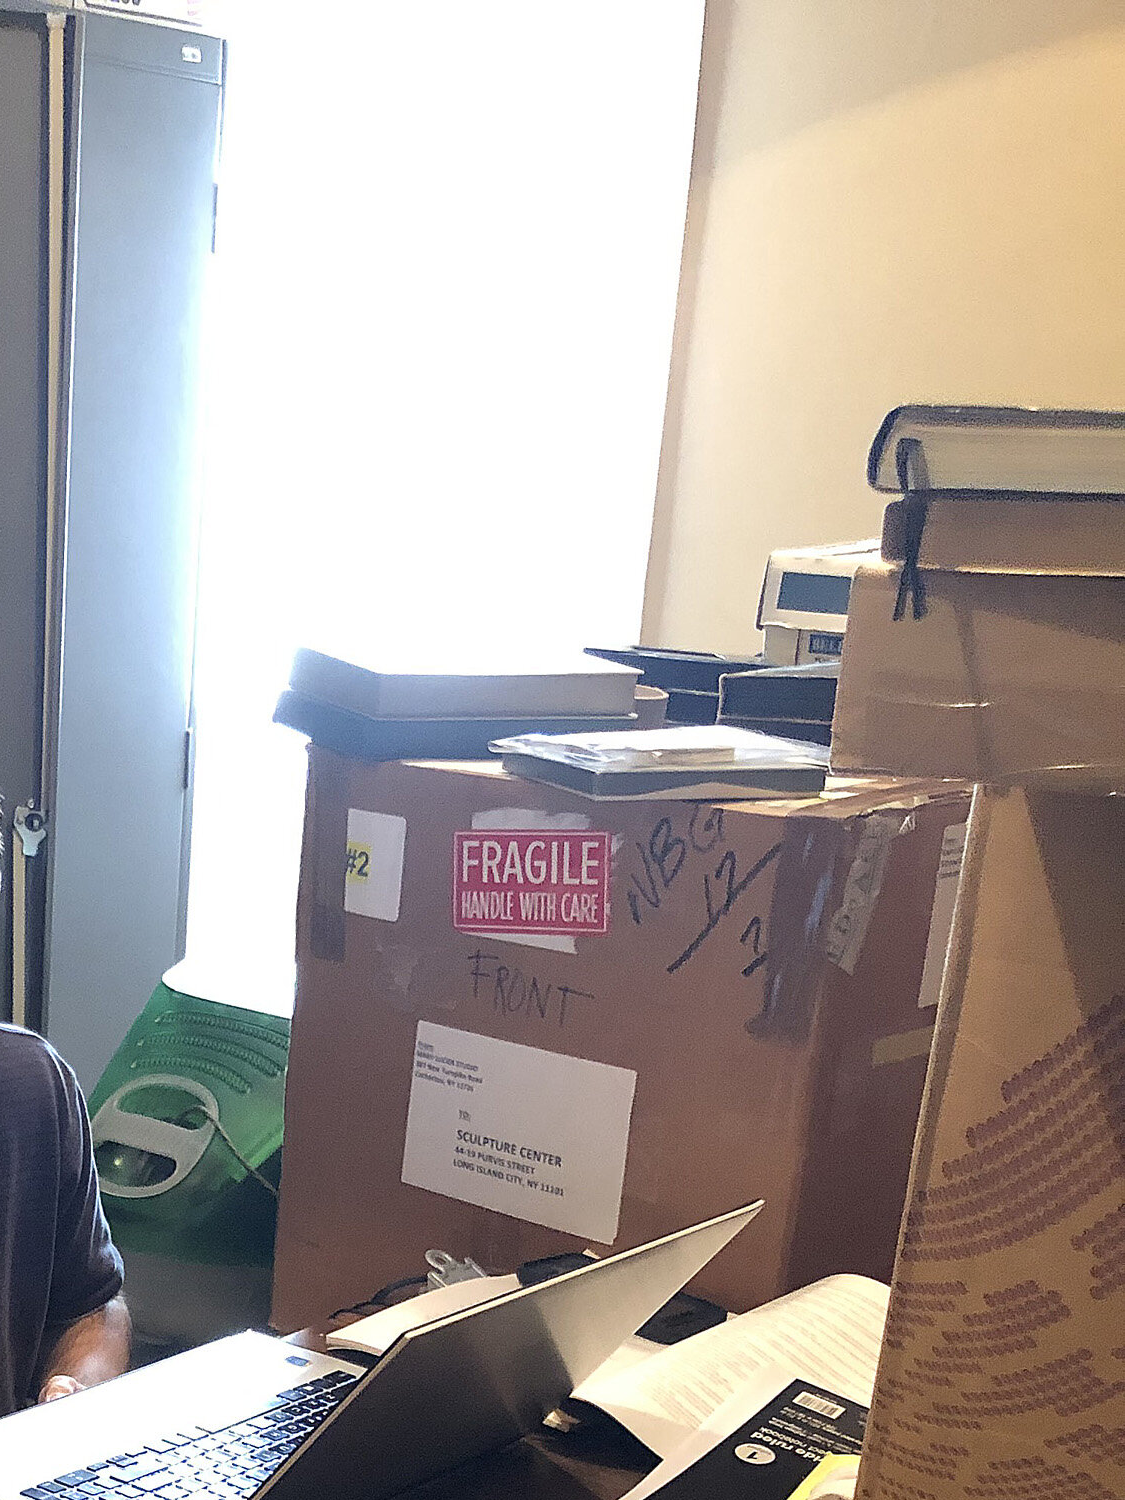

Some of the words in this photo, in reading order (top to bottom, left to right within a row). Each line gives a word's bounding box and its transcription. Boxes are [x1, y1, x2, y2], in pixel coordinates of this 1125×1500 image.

[346, 848, 370, 877] #2
[462, 841, 600, 885] FRAGILE
[461, 890, 514, 922] HANDLE
[519, 891, 557, 922] WITH
[561, 892, 599, 924] CARE
[467, 950, 595, 1026] FRONT
[456, 1128, 518, 1156] SCULPTURE
[519, 1147, 563, 1168] CENTER
[477, 1151, 506, 1167] PURVIS
[506, 1160, 536, 1175] STREET
[453, 1158, 475, 1171] LONG
[476, 1164, 505, 1180] ISLAND
[526, 1179, 540, 1190] NY
[540, 1181, 565, 1197] 11101
[749, 1431, 796, 1451] ruled
[758, 1426, 808, 1448] notebook
